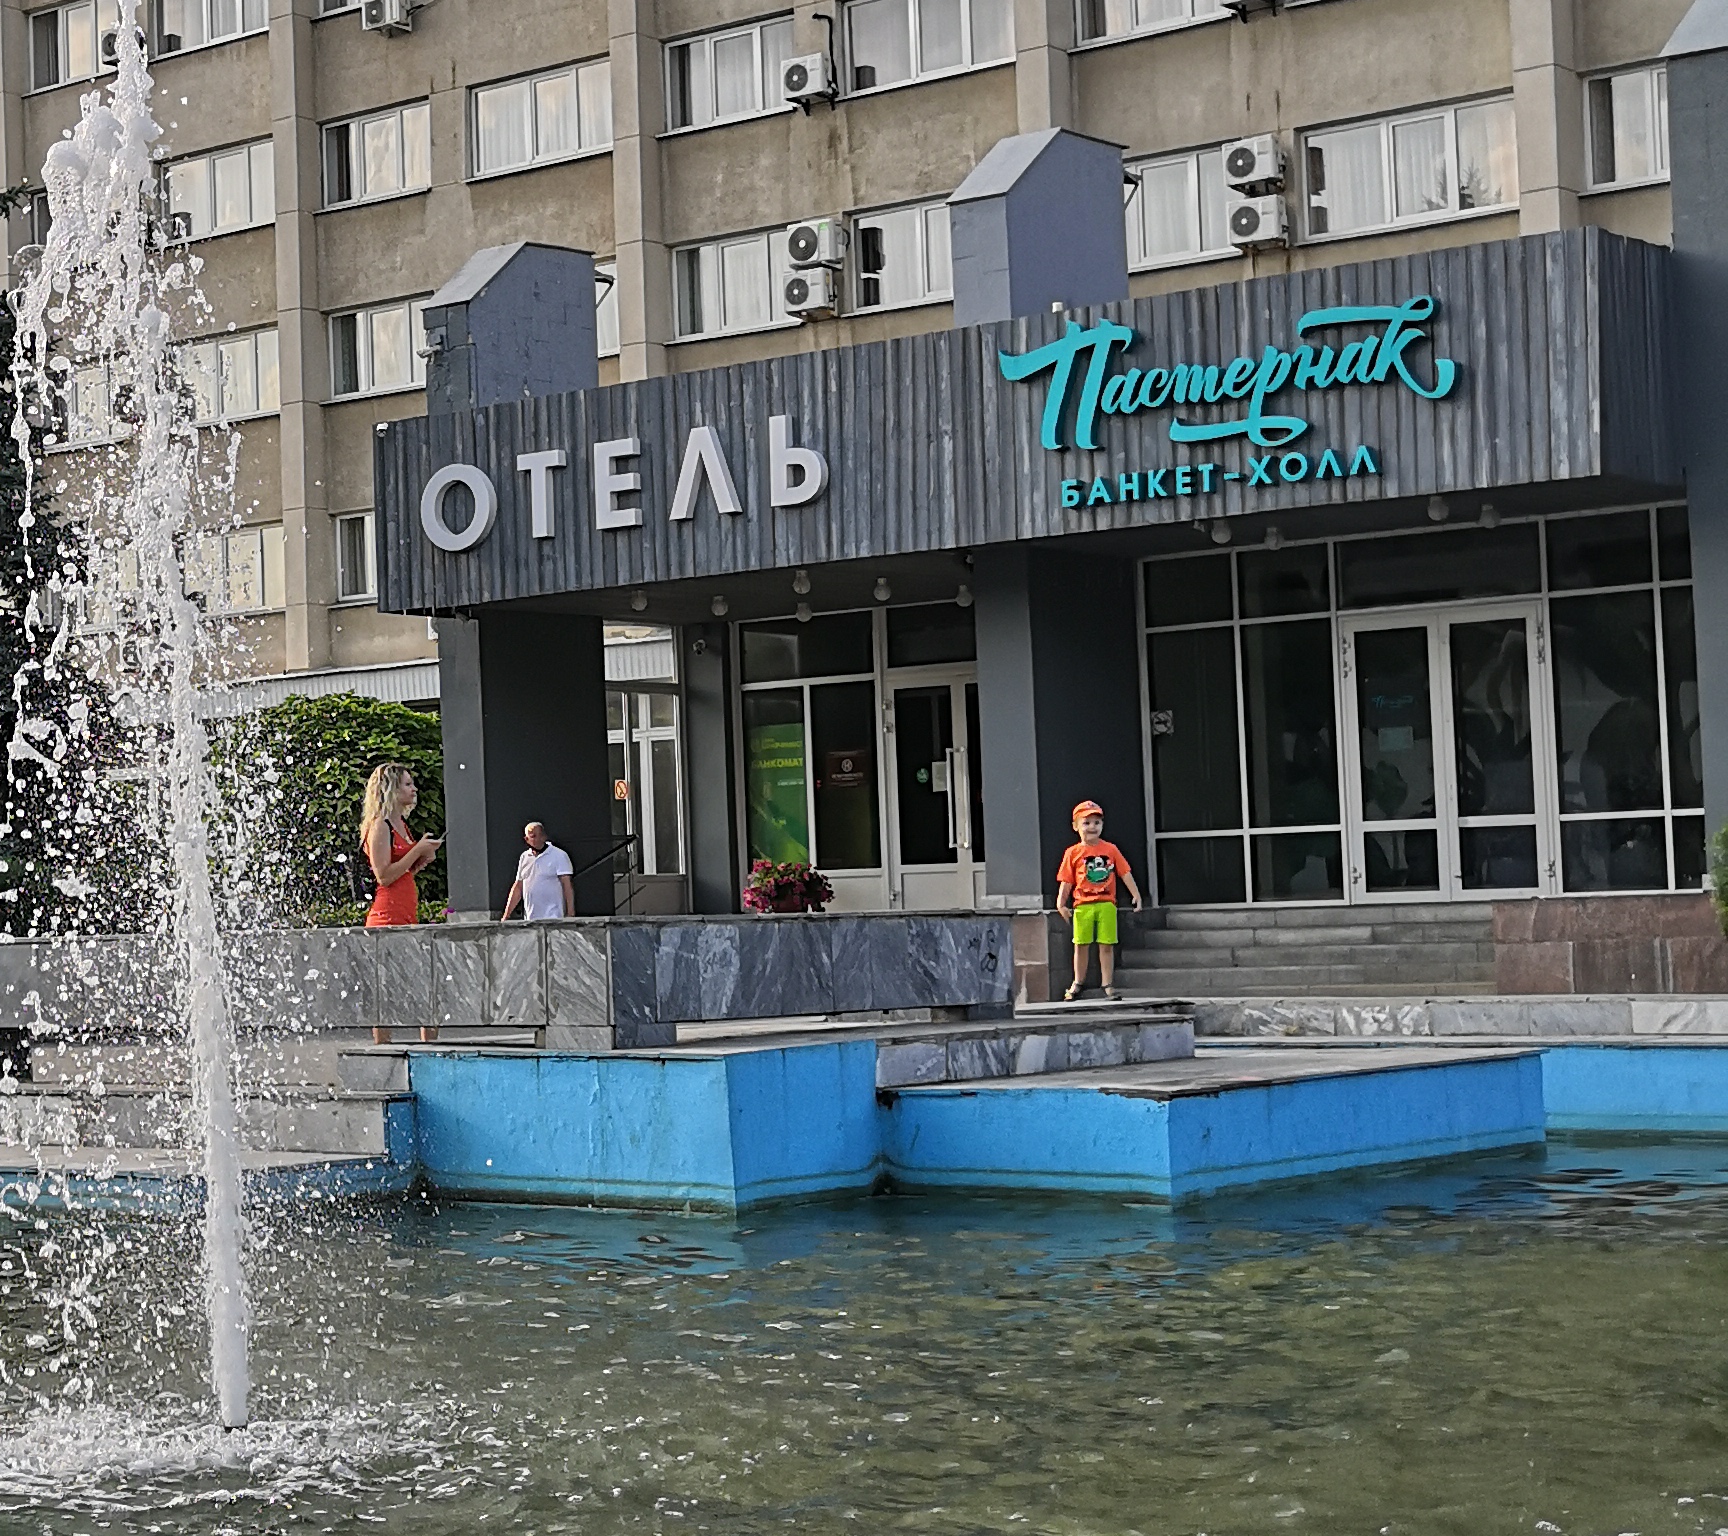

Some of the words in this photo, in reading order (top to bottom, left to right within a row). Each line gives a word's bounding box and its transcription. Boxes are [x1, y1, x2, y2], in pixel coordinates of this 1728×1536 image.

[998, 294, 1458, 452] Пастернак
[419, 413, 830, 552] ОТЕЛЬ
[1060, 444, 1380, 509] БАНКЕТ-ХОЛЛ
